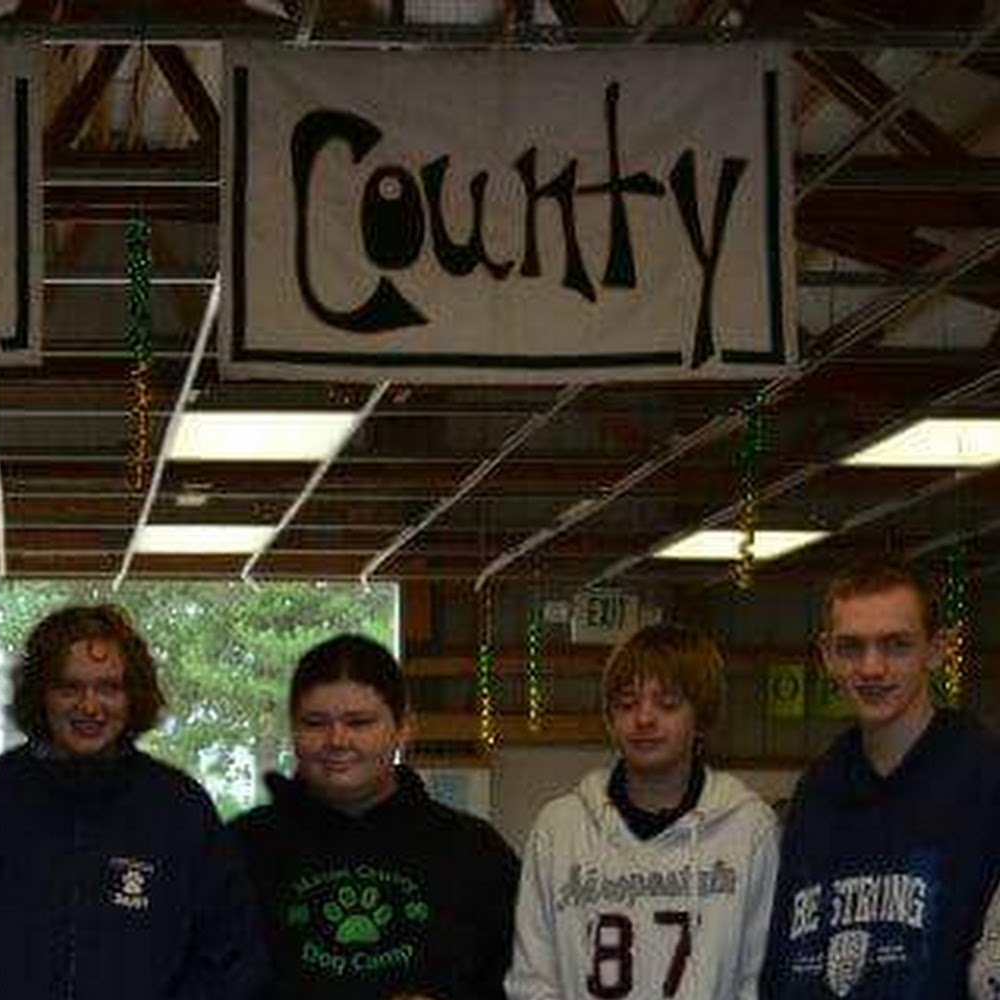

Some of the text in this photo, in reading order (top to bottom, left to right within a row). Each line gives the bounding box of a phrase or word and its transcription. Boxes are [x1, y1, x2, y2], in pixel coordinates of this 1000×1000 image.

[290, 82, 746, 370] County
[301, 938, 347, 977] Dog
[586, 912, 692, 1000] 87
